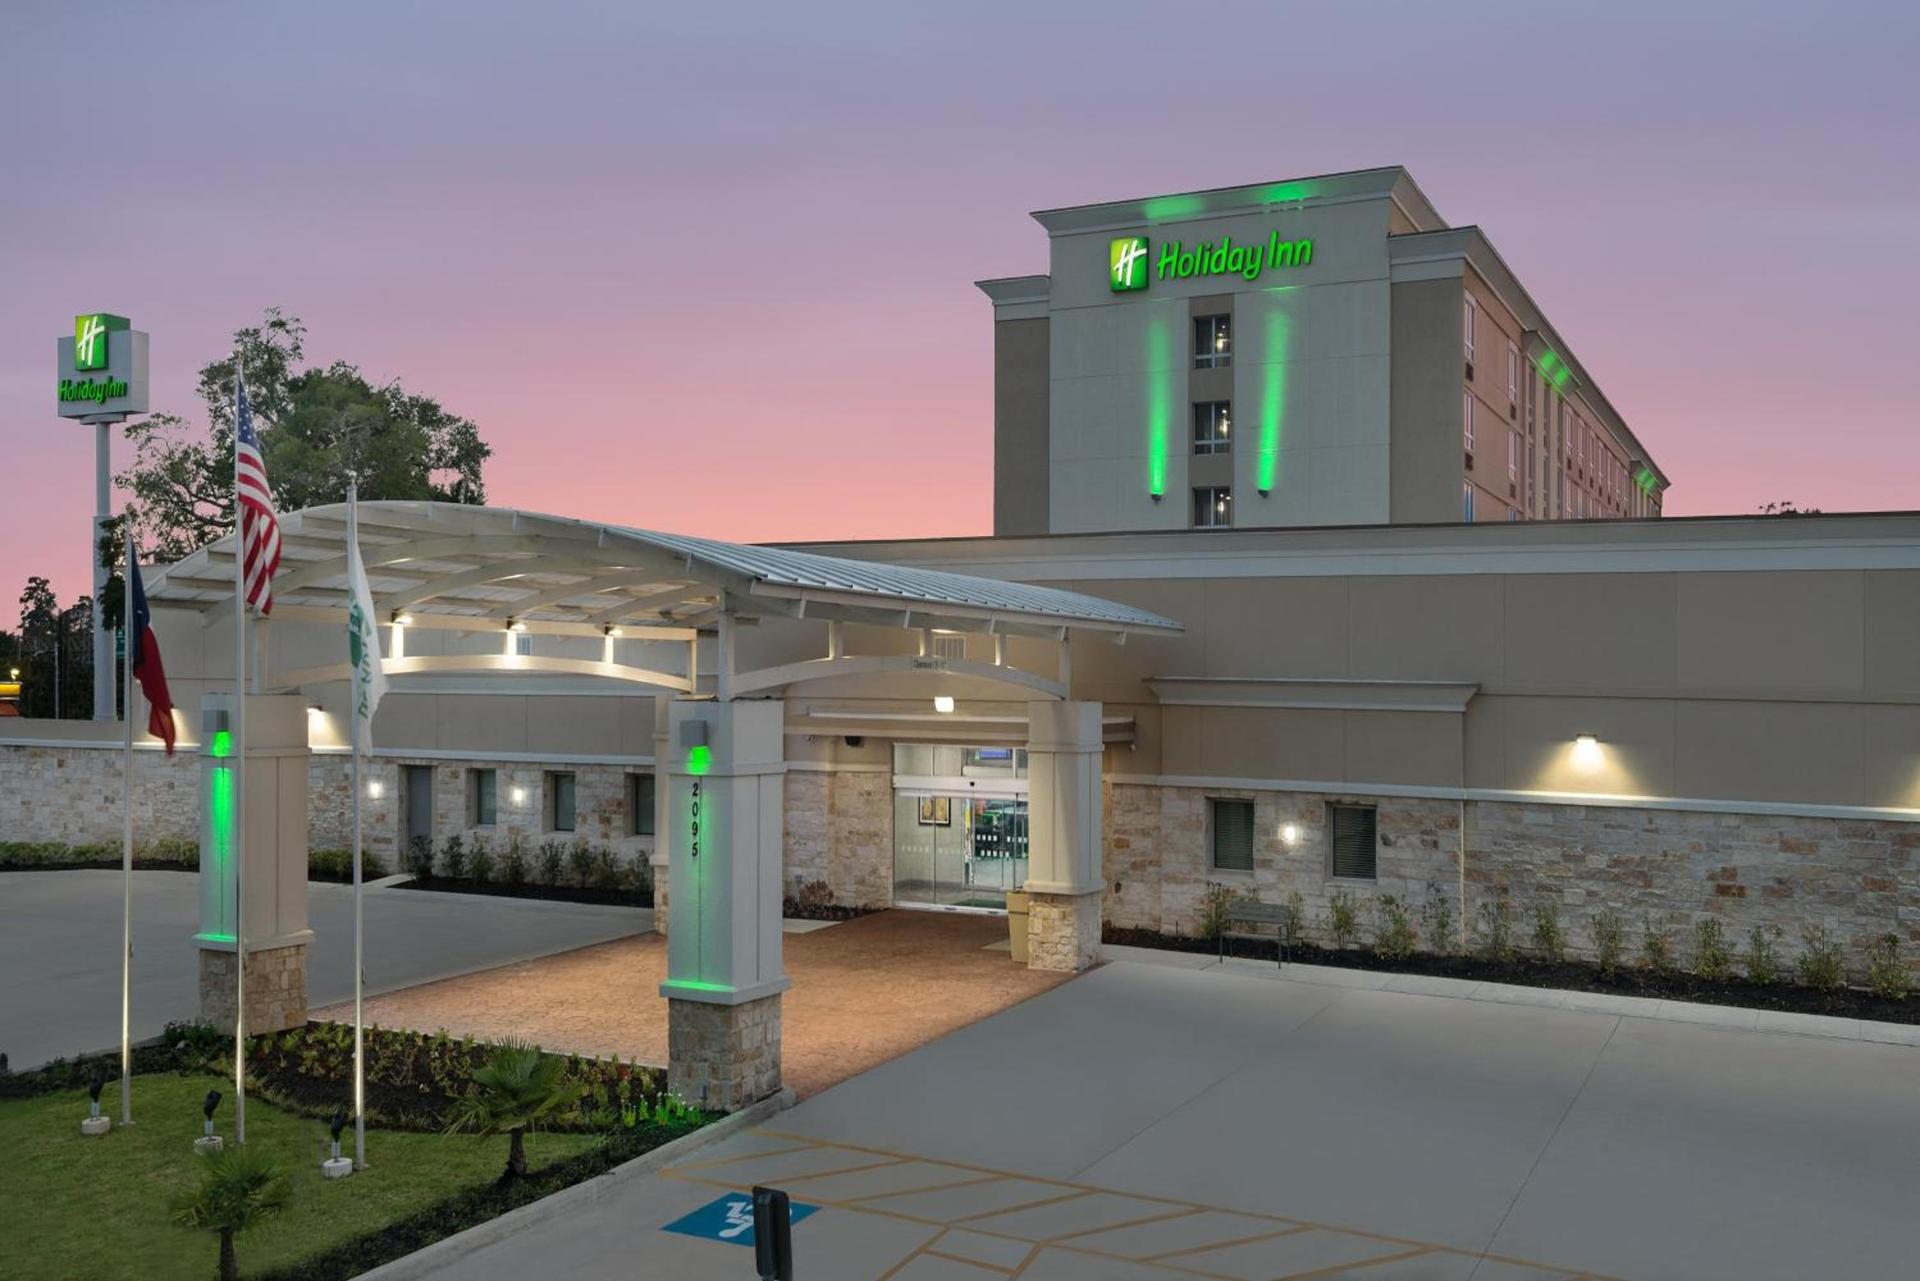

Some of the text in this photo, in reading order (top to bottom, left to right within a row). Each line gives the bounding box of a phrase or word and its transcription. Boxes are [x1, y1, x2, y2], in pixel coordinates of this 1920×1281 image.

[1156, 229, 1313, 282] Holiday Inn
[59, 375, 128, 405] Holiday Inn
[691, 781, 699, 858] 2095
